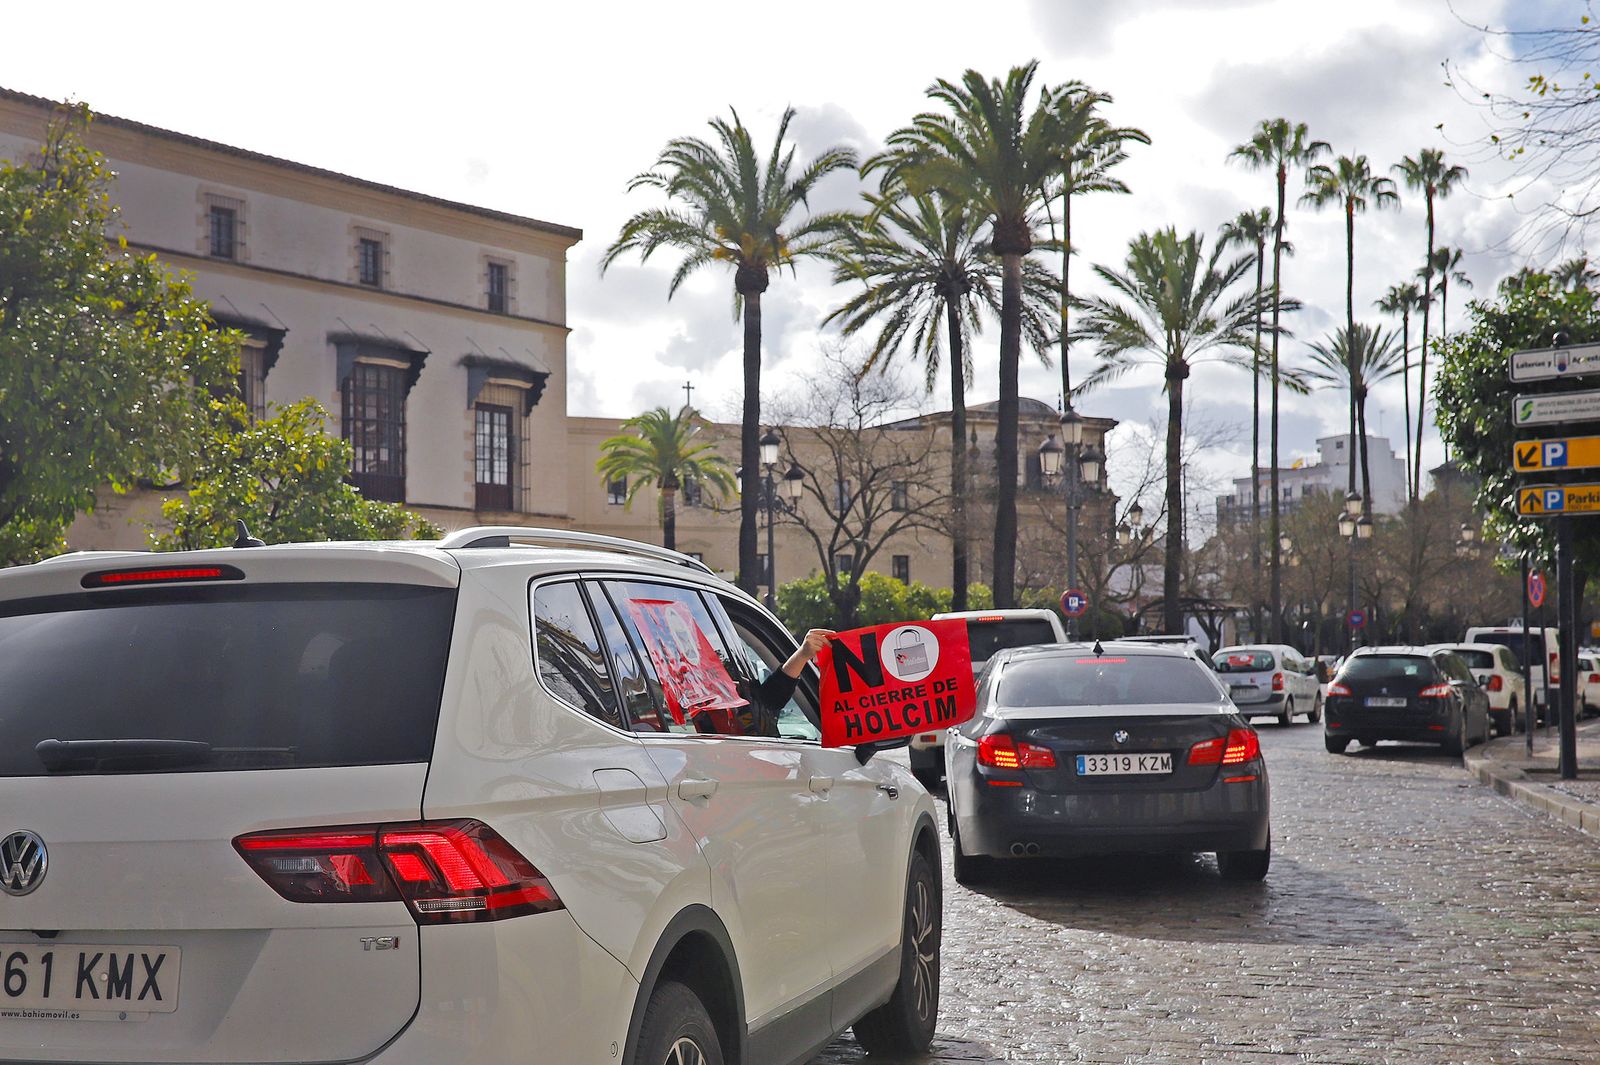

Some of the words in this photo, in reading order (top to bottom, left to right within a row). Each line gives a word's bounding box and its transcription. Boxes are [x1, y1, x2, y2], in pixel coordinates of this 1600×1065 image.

[1545, 443, 1564, 467] P
[1547, 491, 1560, 509] P
[834, 700, 854, 713] AL
[859, 684, 927, 709] CIERRE
[934, 677, 958, 694] DE
[844, 694, 957, 738] HOLCIM
[1088, 757, 1131, 772] 3319
[1138, 757, 1170, 771] KZM
[360, 936, 399, 951] TSI
[0, 951, 53, 998] 61
[75, 952, 166, 1000] KMX
[1, 1010, 80, 1020] www.bahiamovil.es
